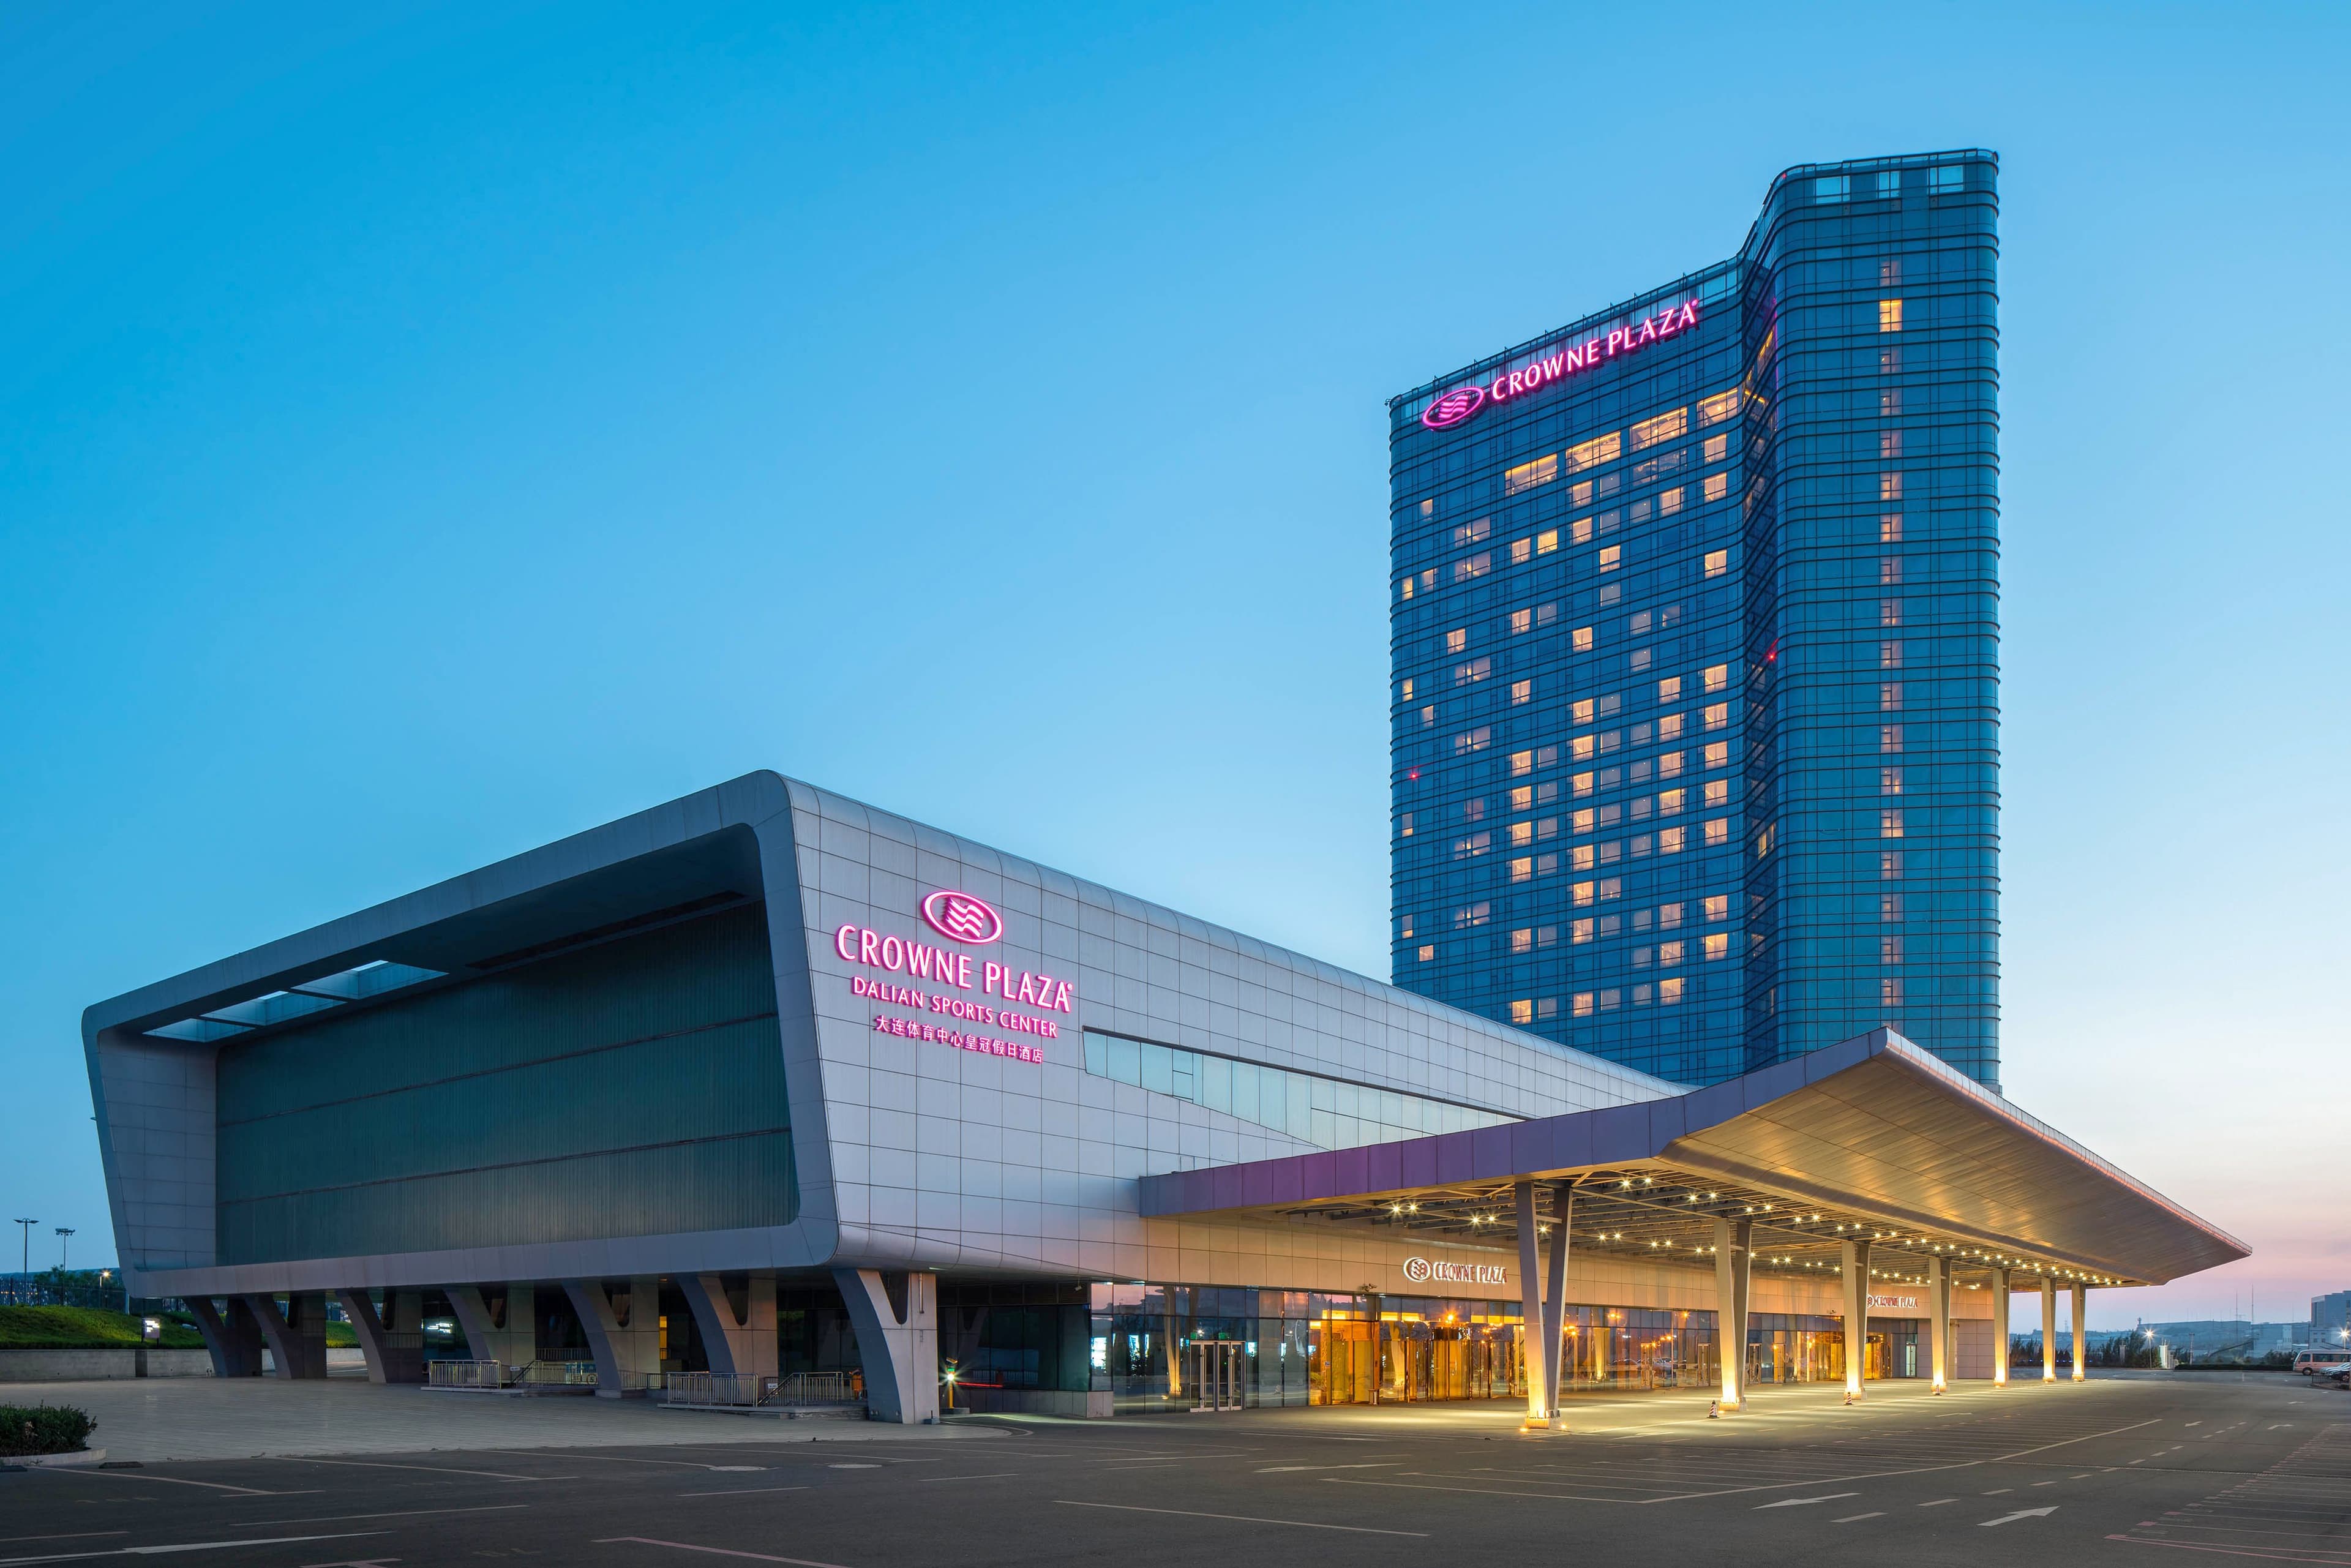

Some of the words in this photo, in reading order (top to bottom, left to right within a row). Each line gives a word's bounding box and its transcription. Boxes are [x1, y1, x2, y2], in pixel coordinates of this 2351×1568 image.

[1491, 339, 1600, 400] CROWNE
[1607, 302, 1696, 355] PLAZA
[836, 924, 972, 989] CROWNE
[983, 960, 1071, 1013] PLAZA
[852, 976, 925, 1008] DALIAN
[930, 995, 994, 1024] SPORTS
[997, 1011, 1059, 1039] CENTER
[874, 1015, 1043, 1063] 大连体育中心皇冠假日酒店
[1433, 1262, 1475, 1282] CROWNE
[1476, 1265, 1507, 1284] PLAZA
